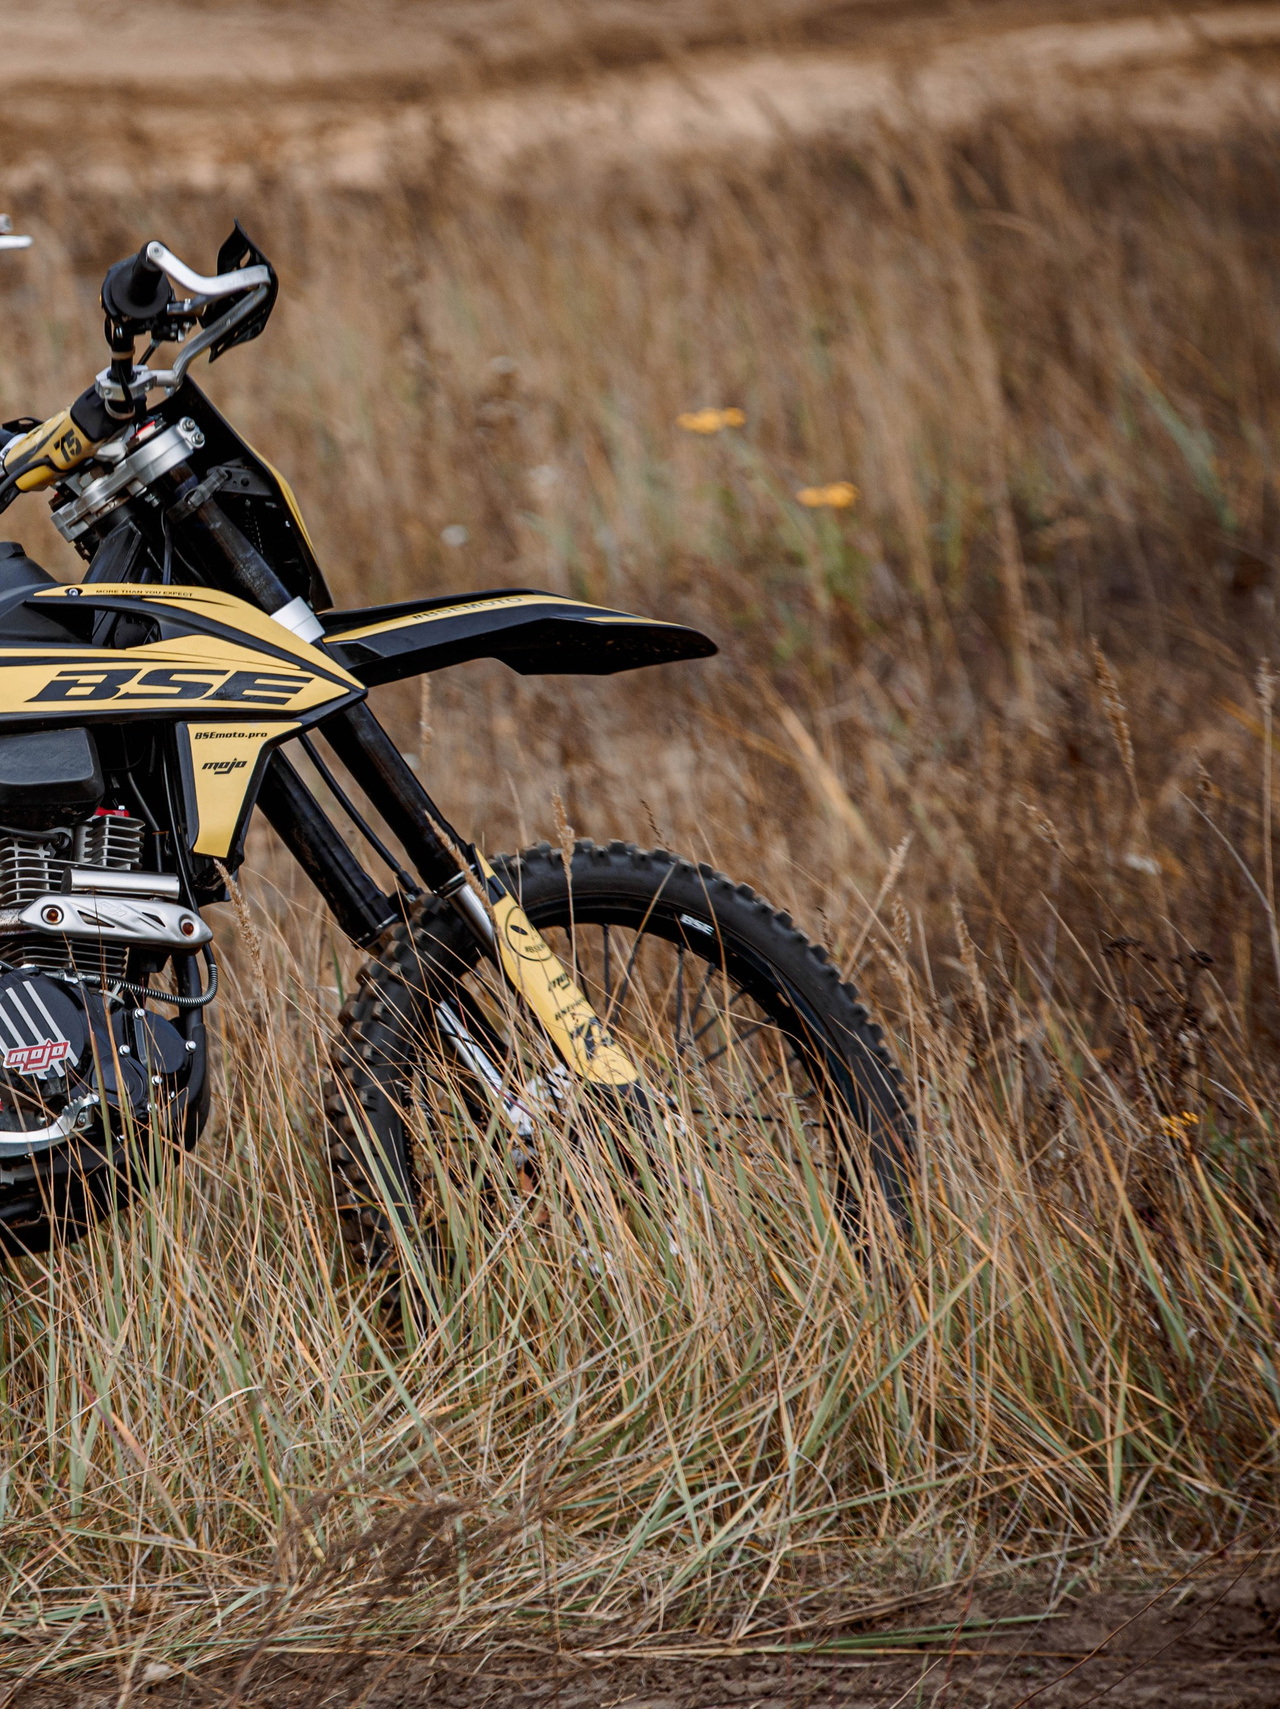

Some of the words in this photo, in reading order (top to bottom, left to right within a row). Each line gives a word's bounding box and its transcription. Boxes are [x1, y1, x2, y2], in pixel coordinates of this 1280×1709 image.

[25, 668, 315, 706] BSE
[194, 731, 268, 740] BSEmoto.pro
[201, 757, 248, 775] mojo
[8, 1041, 66, 1070] mojo
